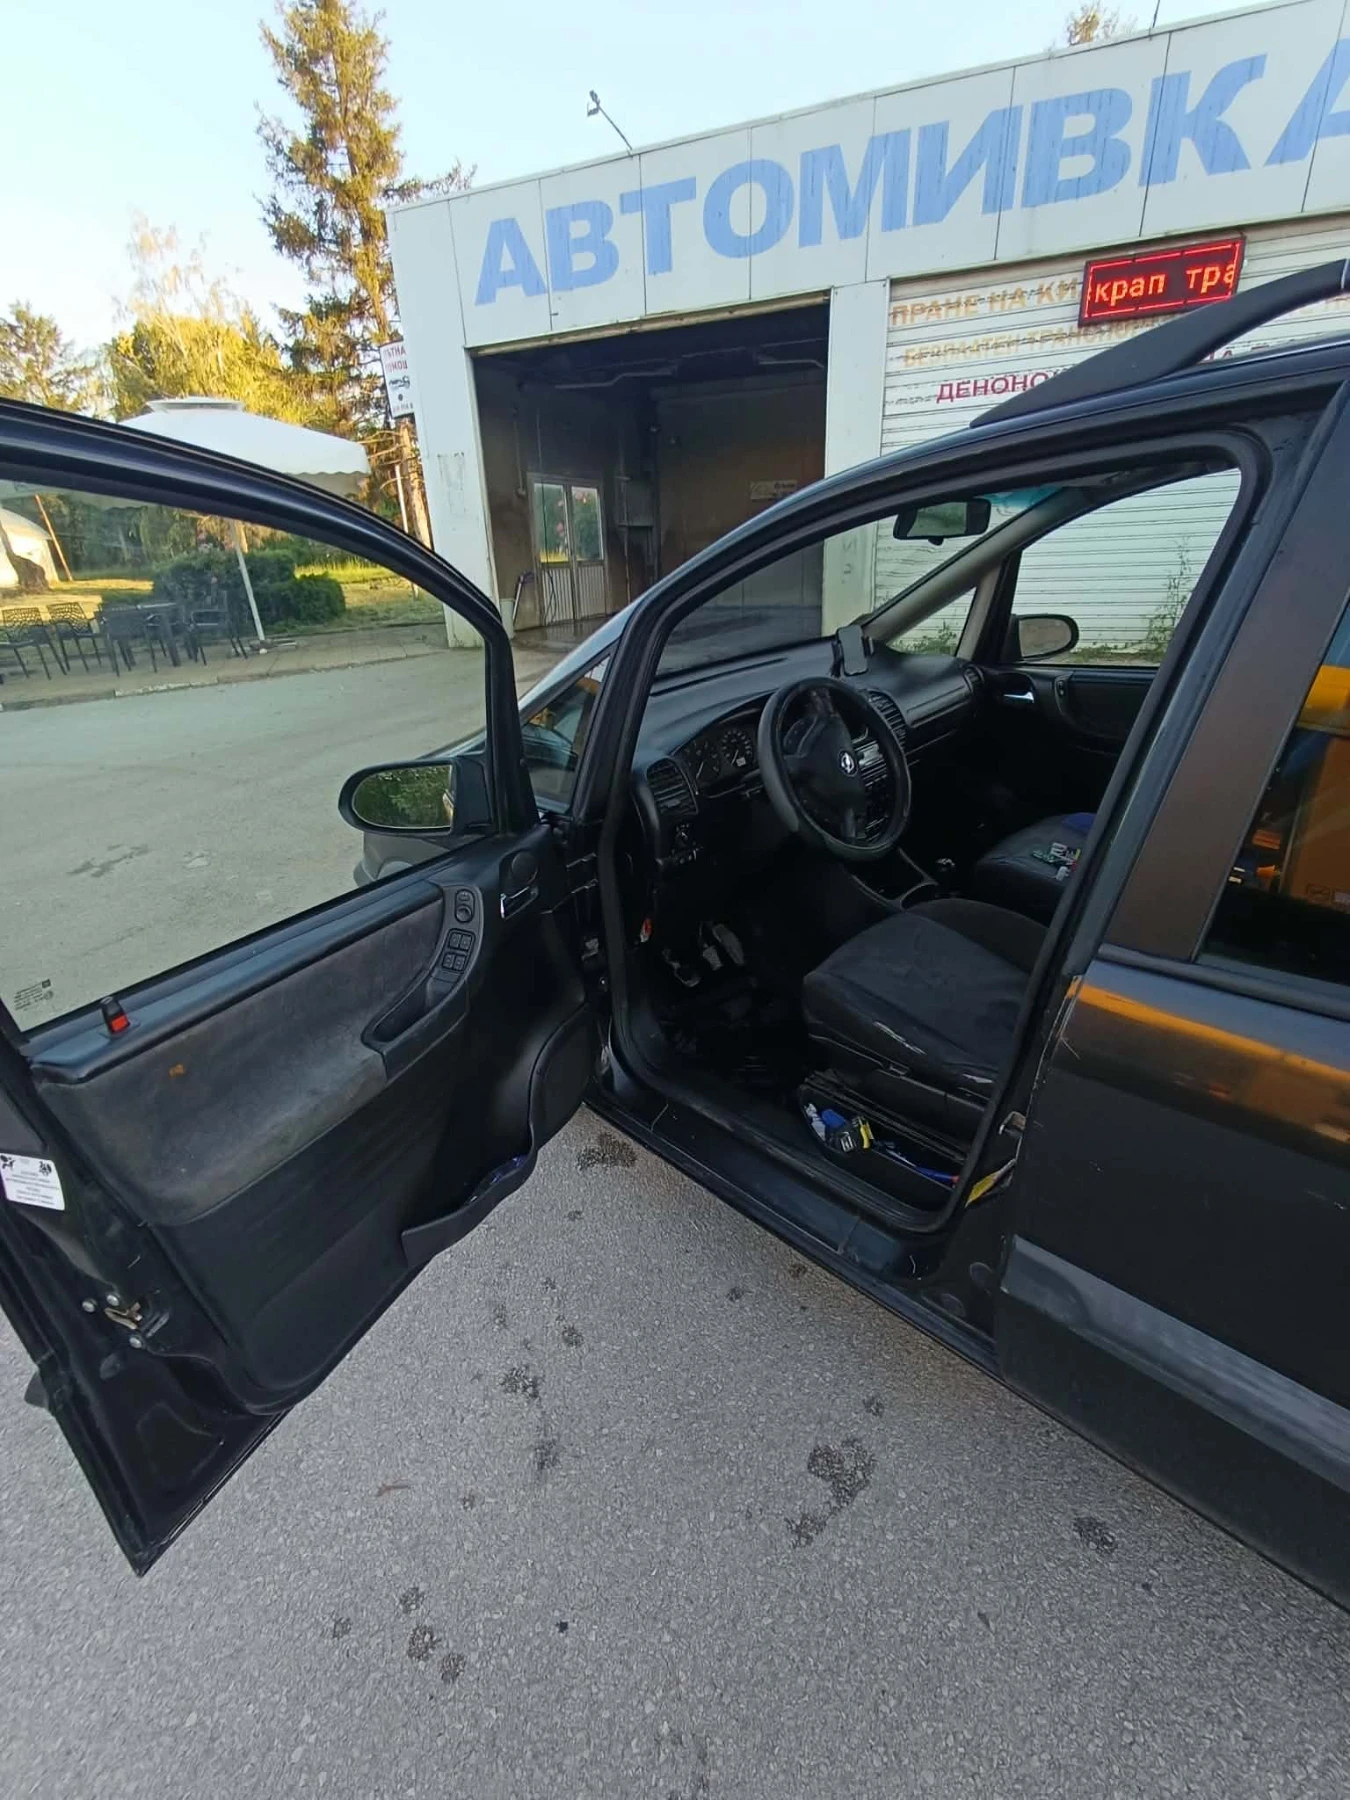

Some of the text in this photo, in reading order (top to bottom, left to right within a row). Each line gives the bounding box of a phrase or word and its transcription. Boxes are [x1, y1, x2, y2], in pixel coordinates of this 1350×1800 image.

[475, 38, 1350, 306] АВТОМИВКА
[891, 278, 1078, 326] ПРАНЕ НА КИ
[1088, 274, 1166, 306] крап
[936, 372, 1051, 404] ДЕНОНО
